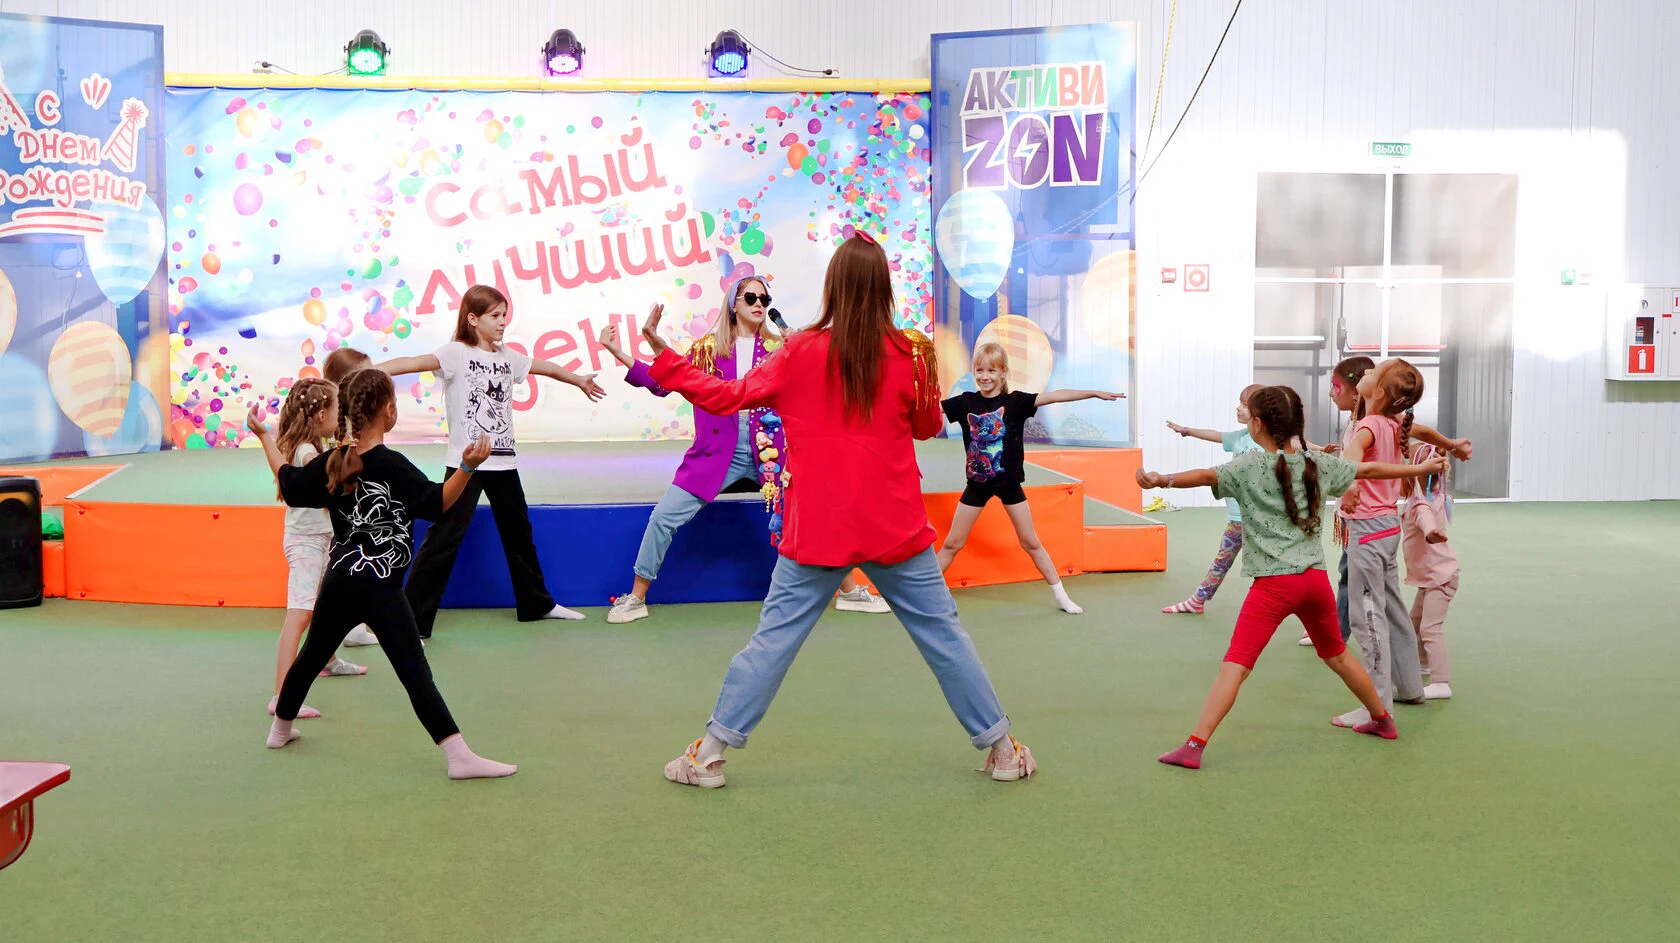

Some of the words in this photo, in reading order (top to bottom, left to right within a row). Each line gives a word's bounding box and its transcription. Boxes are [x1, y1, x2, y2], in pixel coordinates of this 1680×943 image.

[962, 63, 1106, 113] АКТИВИ
[17, 131, 98, 162] Днем
[963, 112, 1105, 188] ZON
